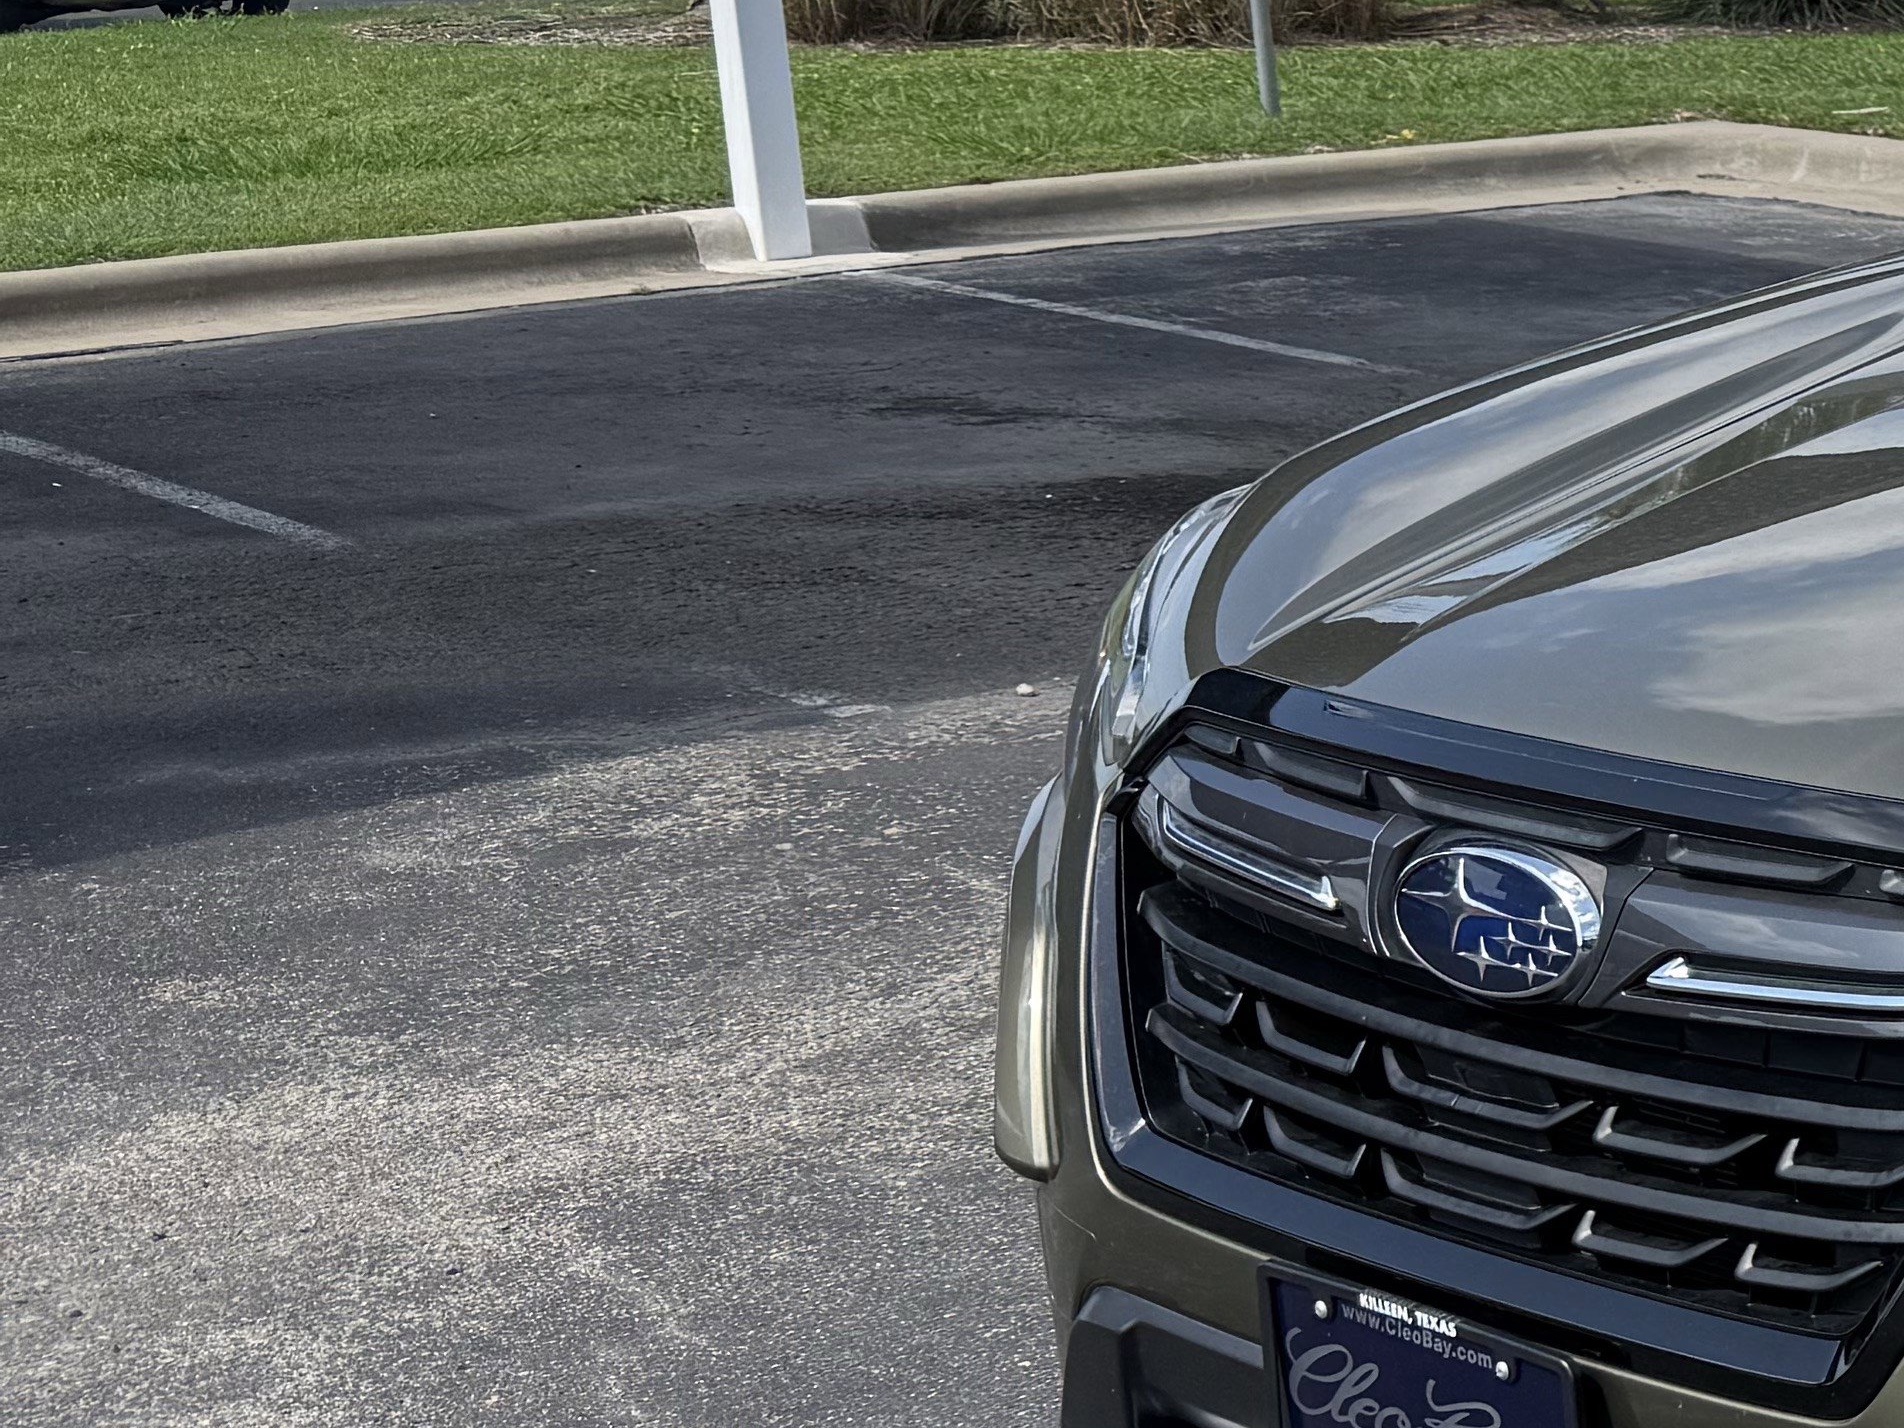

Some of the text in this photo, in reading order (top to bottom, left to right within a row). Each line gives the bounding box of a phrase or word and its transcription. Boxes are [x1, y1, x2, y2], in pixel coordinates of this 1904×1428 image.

[1340, 1303, 1493, 1370] www.CleoBay.com
[1359, 1292, 1457, 1338] KILLEEN, TEXAS
